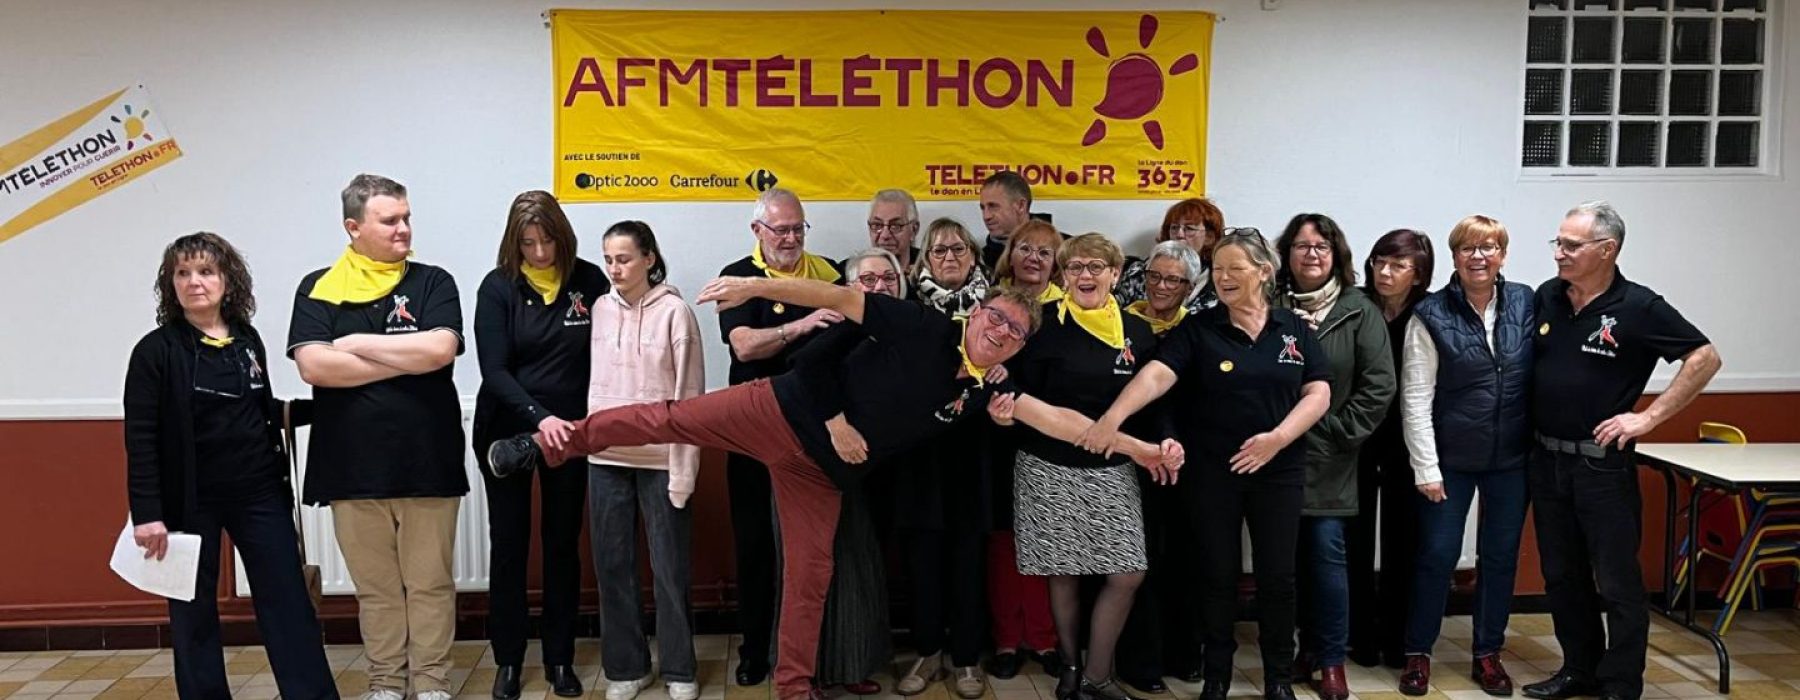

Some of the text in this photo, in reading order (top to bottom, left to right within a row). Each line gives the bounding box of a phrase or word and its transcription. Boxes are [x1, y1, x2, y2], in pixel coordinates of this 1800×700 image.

[564, 153, 640, 161] AVEC LE SOUTIEN DE
[624, 174, 659, 187] 2000
[670, 174, 739, 188] Carrefour
[925, 164, 1116, 186] TELEON.FR
